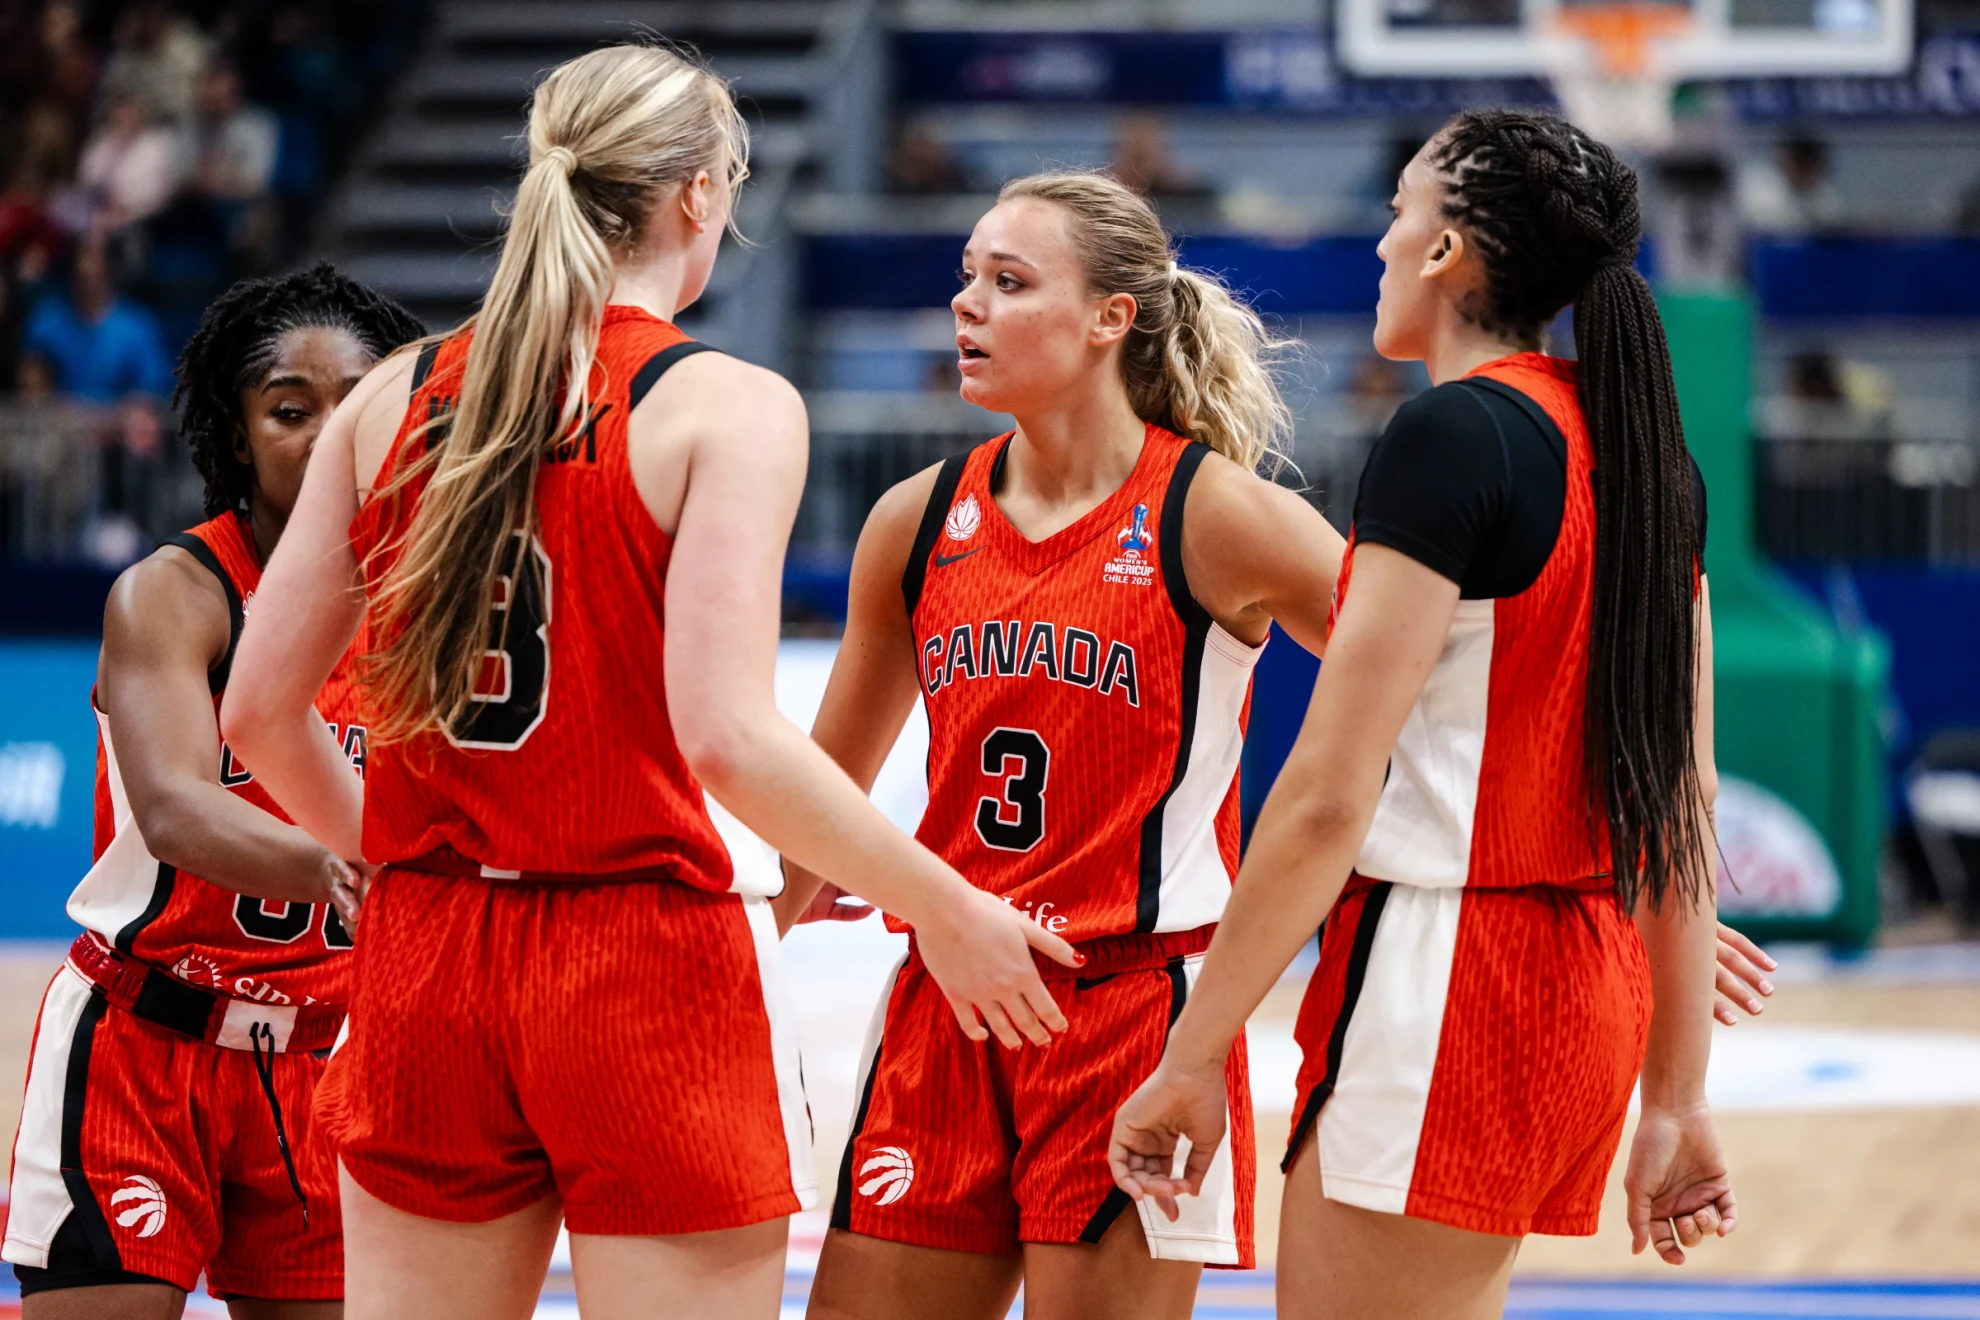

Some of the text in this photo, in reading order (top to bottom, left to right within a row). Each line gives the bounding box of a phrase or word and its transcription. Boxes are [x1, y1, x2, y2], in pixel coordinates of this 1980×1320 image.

[1103, 574, 1152, 585] CHILE 2025
[1104, 562, 1154, 576] AMERICUP
[923, 620, 1140, 708] CANADA
[974, 726, 1051, 853] 3
